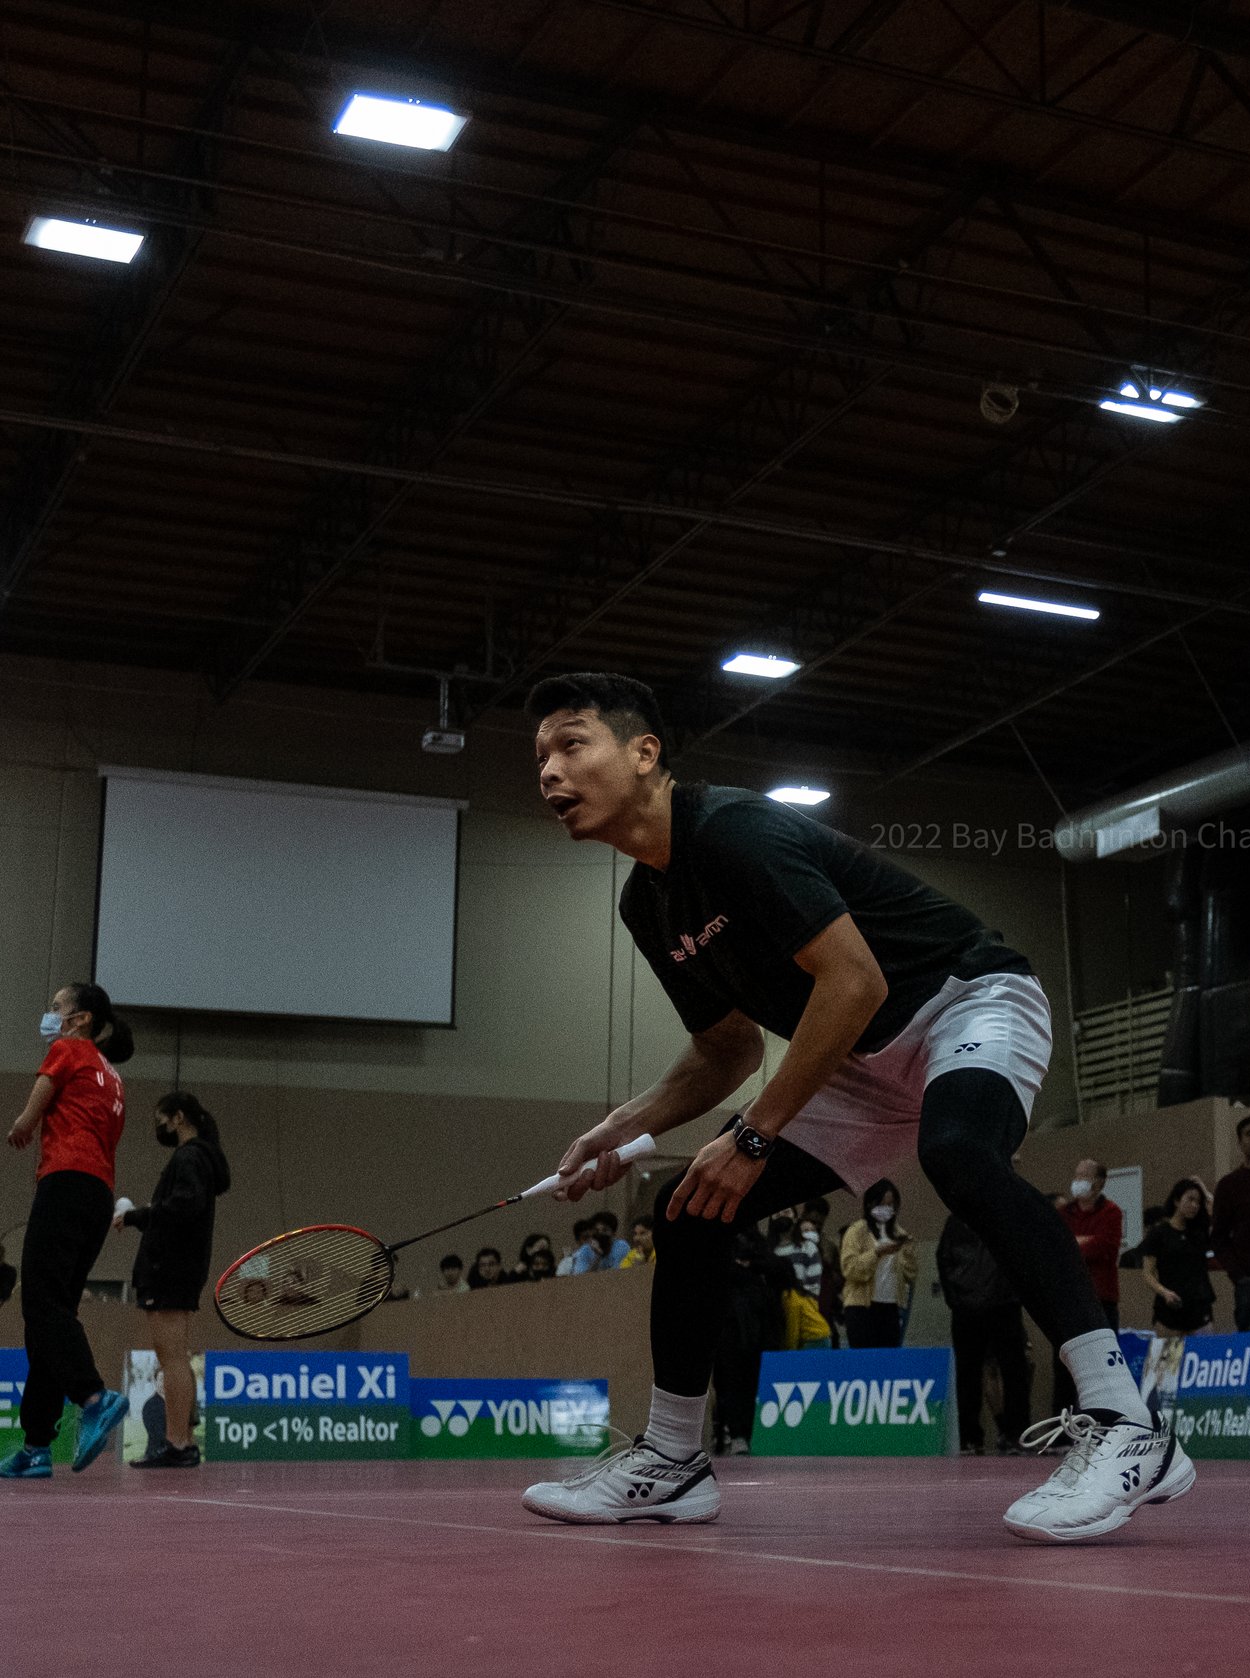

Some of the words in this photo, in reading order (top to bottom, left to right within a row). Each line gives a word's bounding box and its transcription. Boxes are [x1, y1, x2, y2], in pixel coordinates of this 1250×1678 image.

[213, 1363, 347, 1400] Daniel
[357, 1364, 397, 1400] Xi
[1180, 1346, 1250, 1389] Daniel
[486, 1399, 593, 1436] YONEX
[827, 1378, 936, 1425] YONEX
[215, 1416, 258, 1449] Top
[262, 1416, 315, 1443] <1%
[319, 1415, 399, 1443] Realtor
[1175, 1408, 1195, 1444] Top
[1196, 1408, 1222, 1437] <1%
